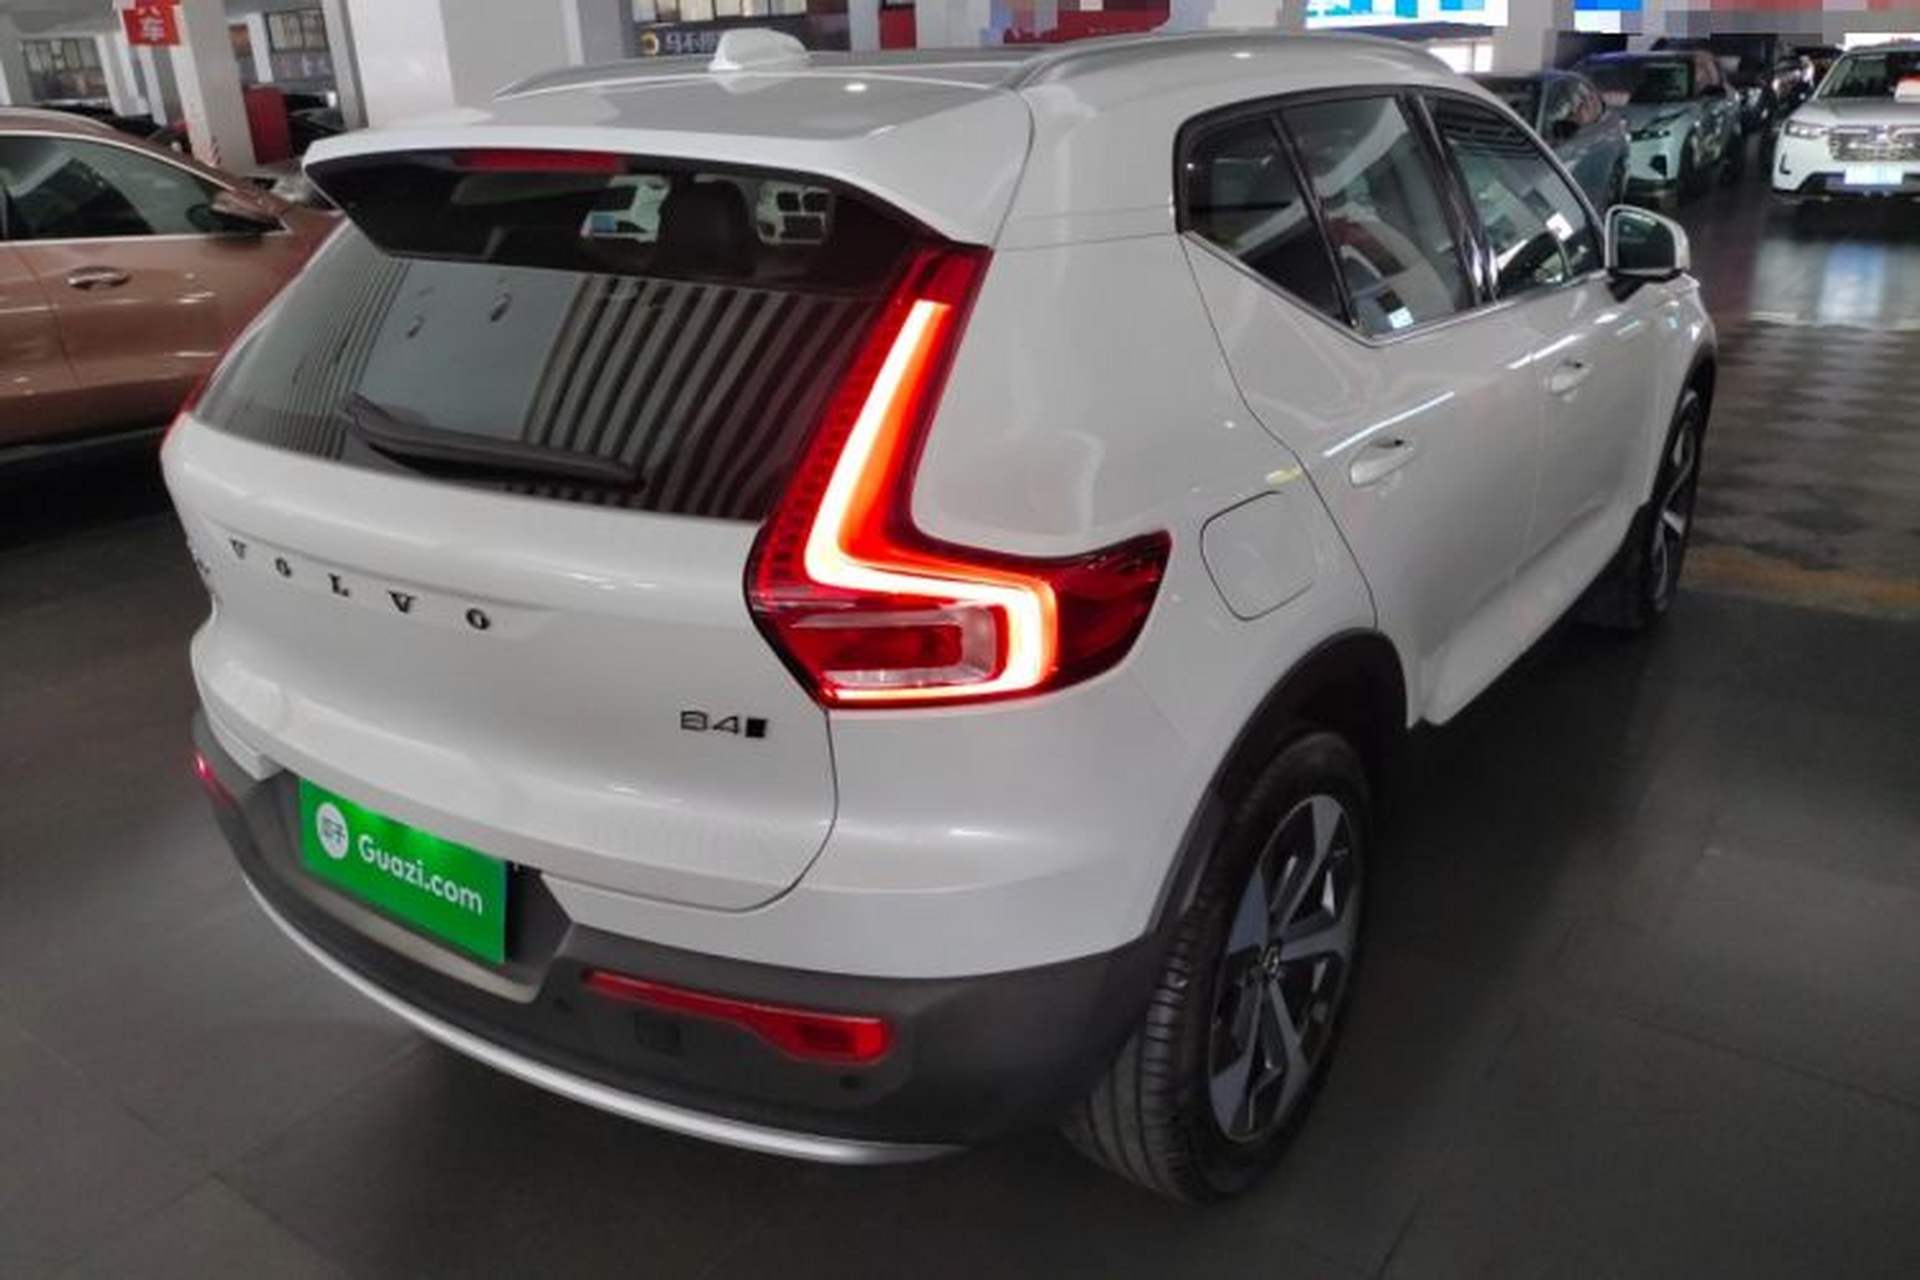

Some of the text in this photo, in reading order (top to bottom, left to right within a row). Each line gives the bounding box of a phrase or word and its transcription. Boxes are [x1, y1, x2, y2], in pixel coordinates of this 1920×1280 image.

[229, 537, 491, 631] VOLVO
[680, 710, 740, 735] B4
[357, 833, 484, 917] Guazi.com
